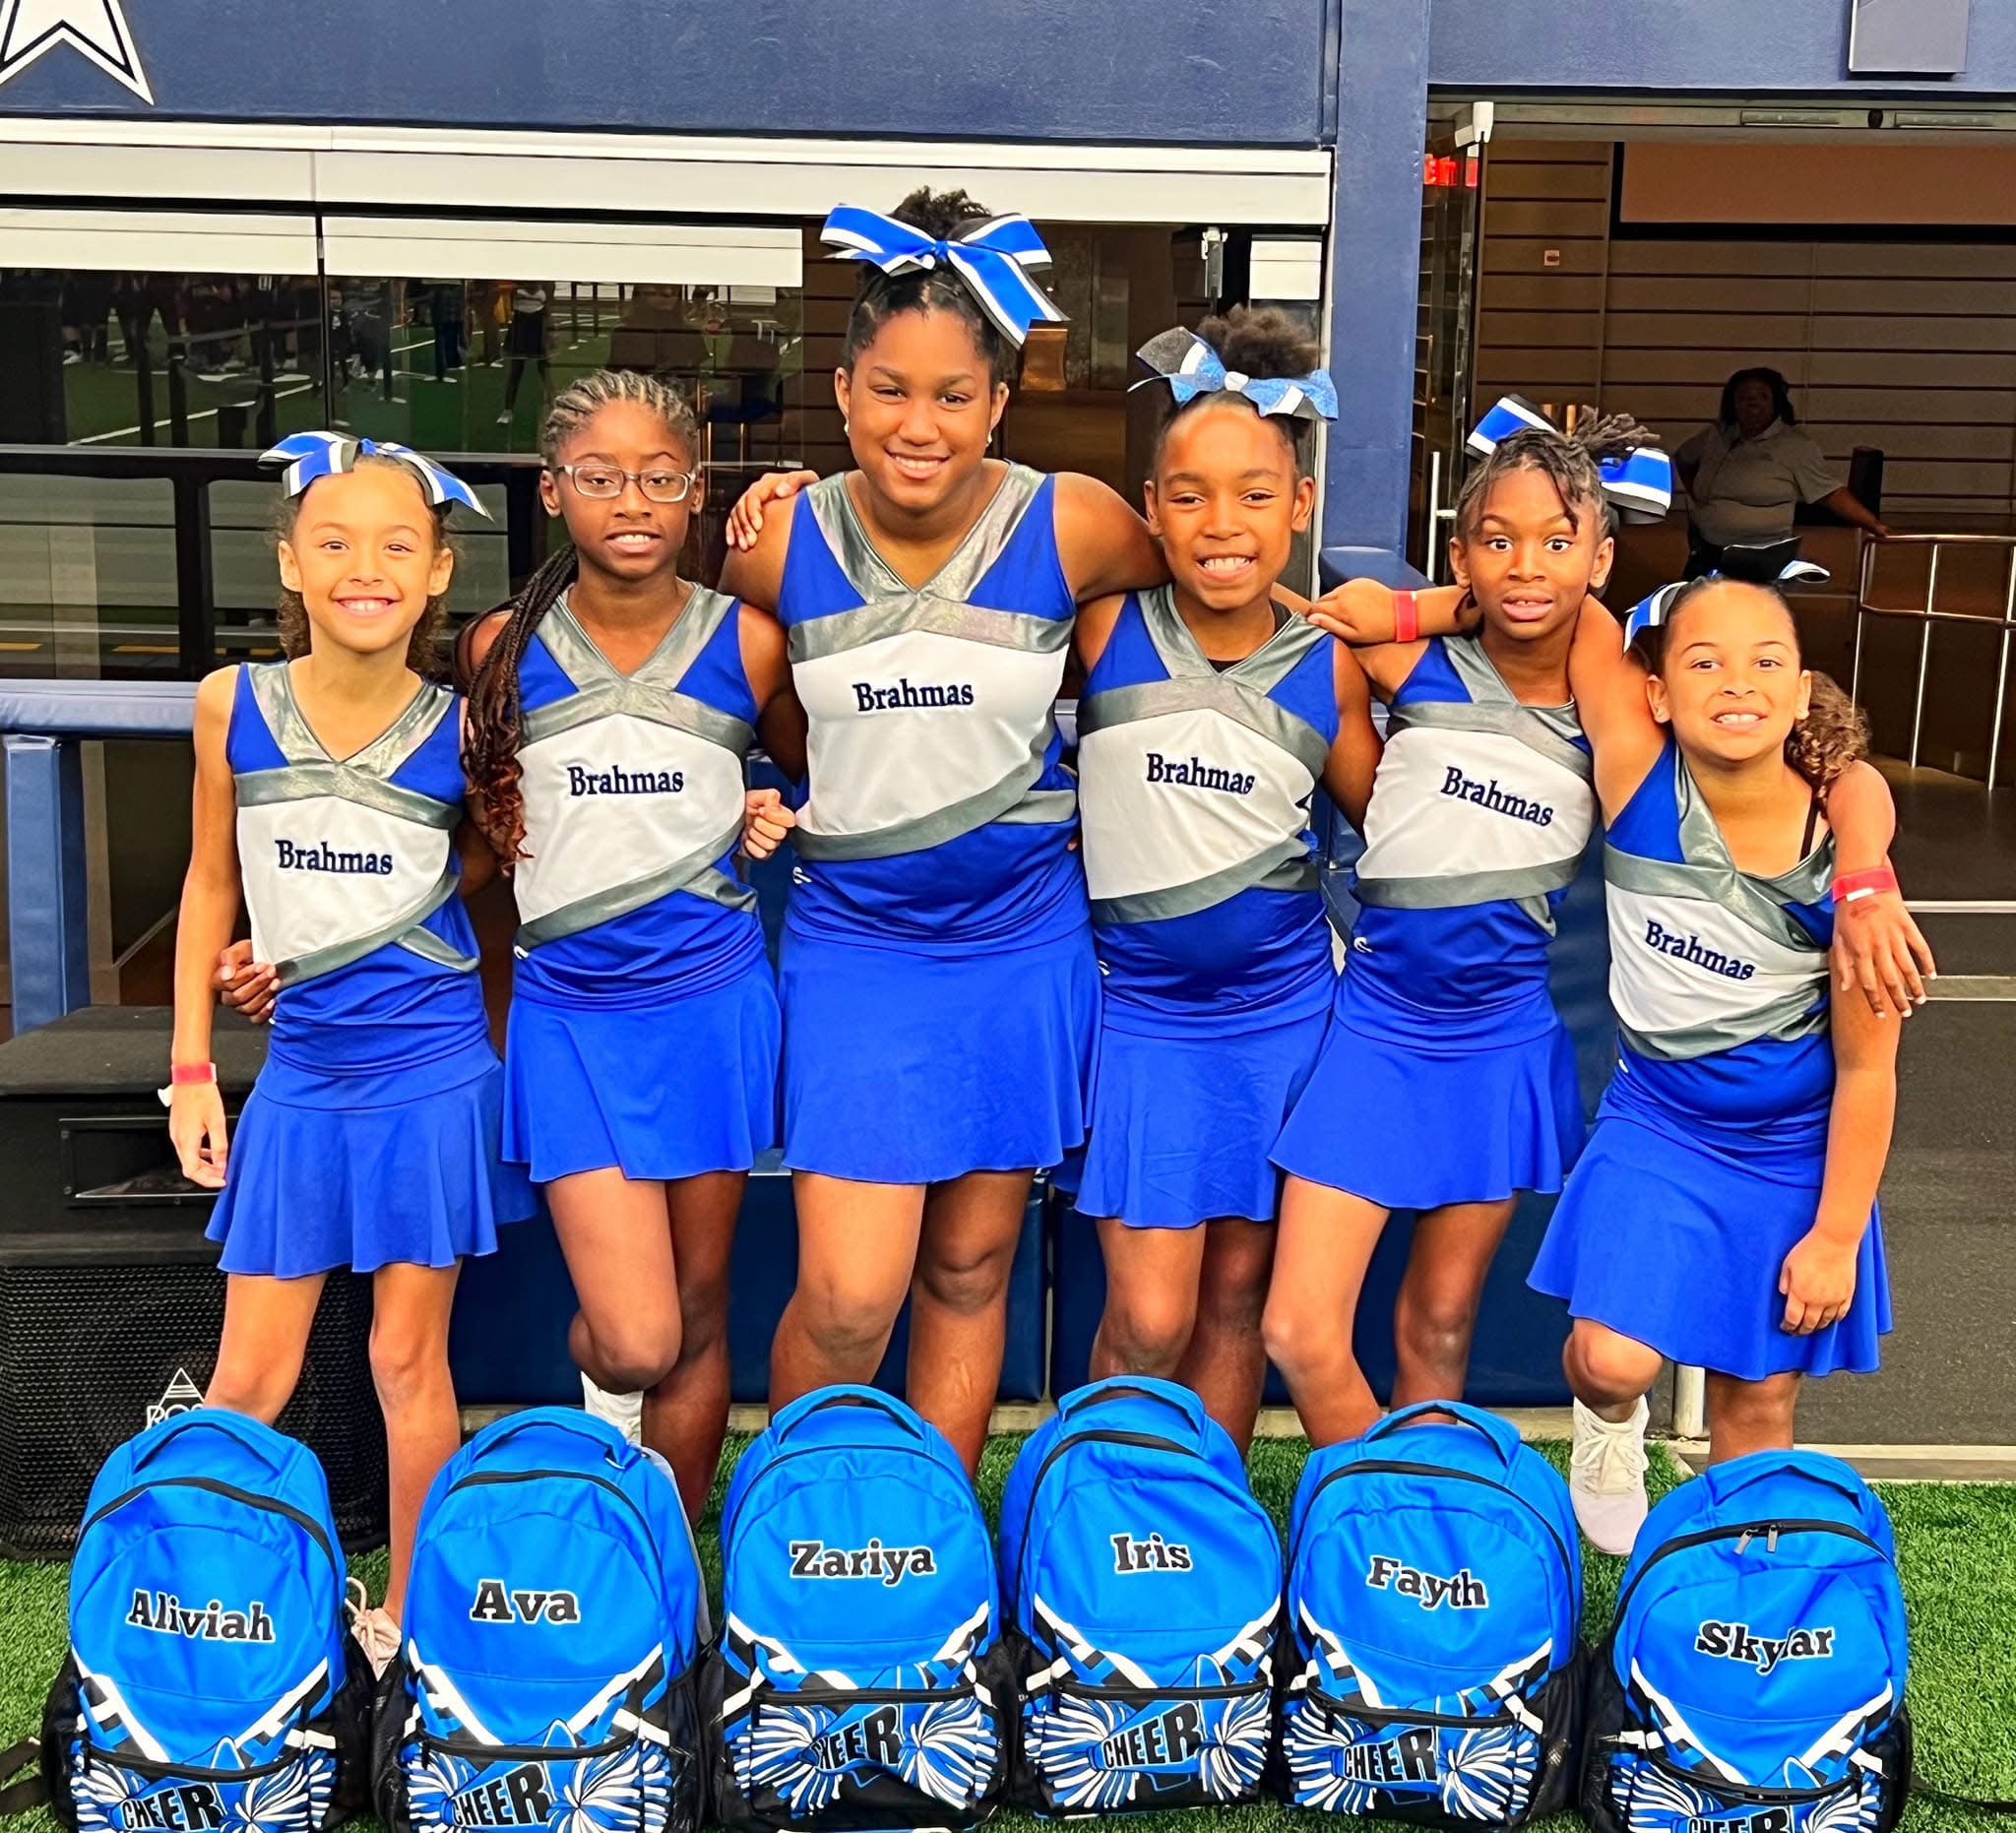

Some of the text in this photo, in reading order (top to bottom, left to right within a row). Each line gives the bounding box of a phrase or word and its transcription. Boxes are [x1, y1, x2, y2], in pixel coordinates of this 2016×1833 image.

[851, 677, 975, 712] Brahmas
[566, 764, 684, 796] Brahmas
[1146, 752, 1255, 795] Brahmas
[1440, 766, 1554, 827] Brahmas
[274, 839, 394, 875] Brahmas
[1645, 918, 1756, 980] Brahmas
[790, 1539, 936, 1586] Zariya
[1111, 1533, 1193, 1573] Iris
[470, 1579, 581, 1624] Ava
[1366, 1555, 1488, 1610] Fayth
[126, 1589, 276, 1643] Aliviah
[1102, 1702, 1202, 1769] CHEER
[1345, 1727, 1437, 1783] CHEER
[121, 1784, 222, 1831] CHEER
[452, 1762, 552, 1825] CHEER
